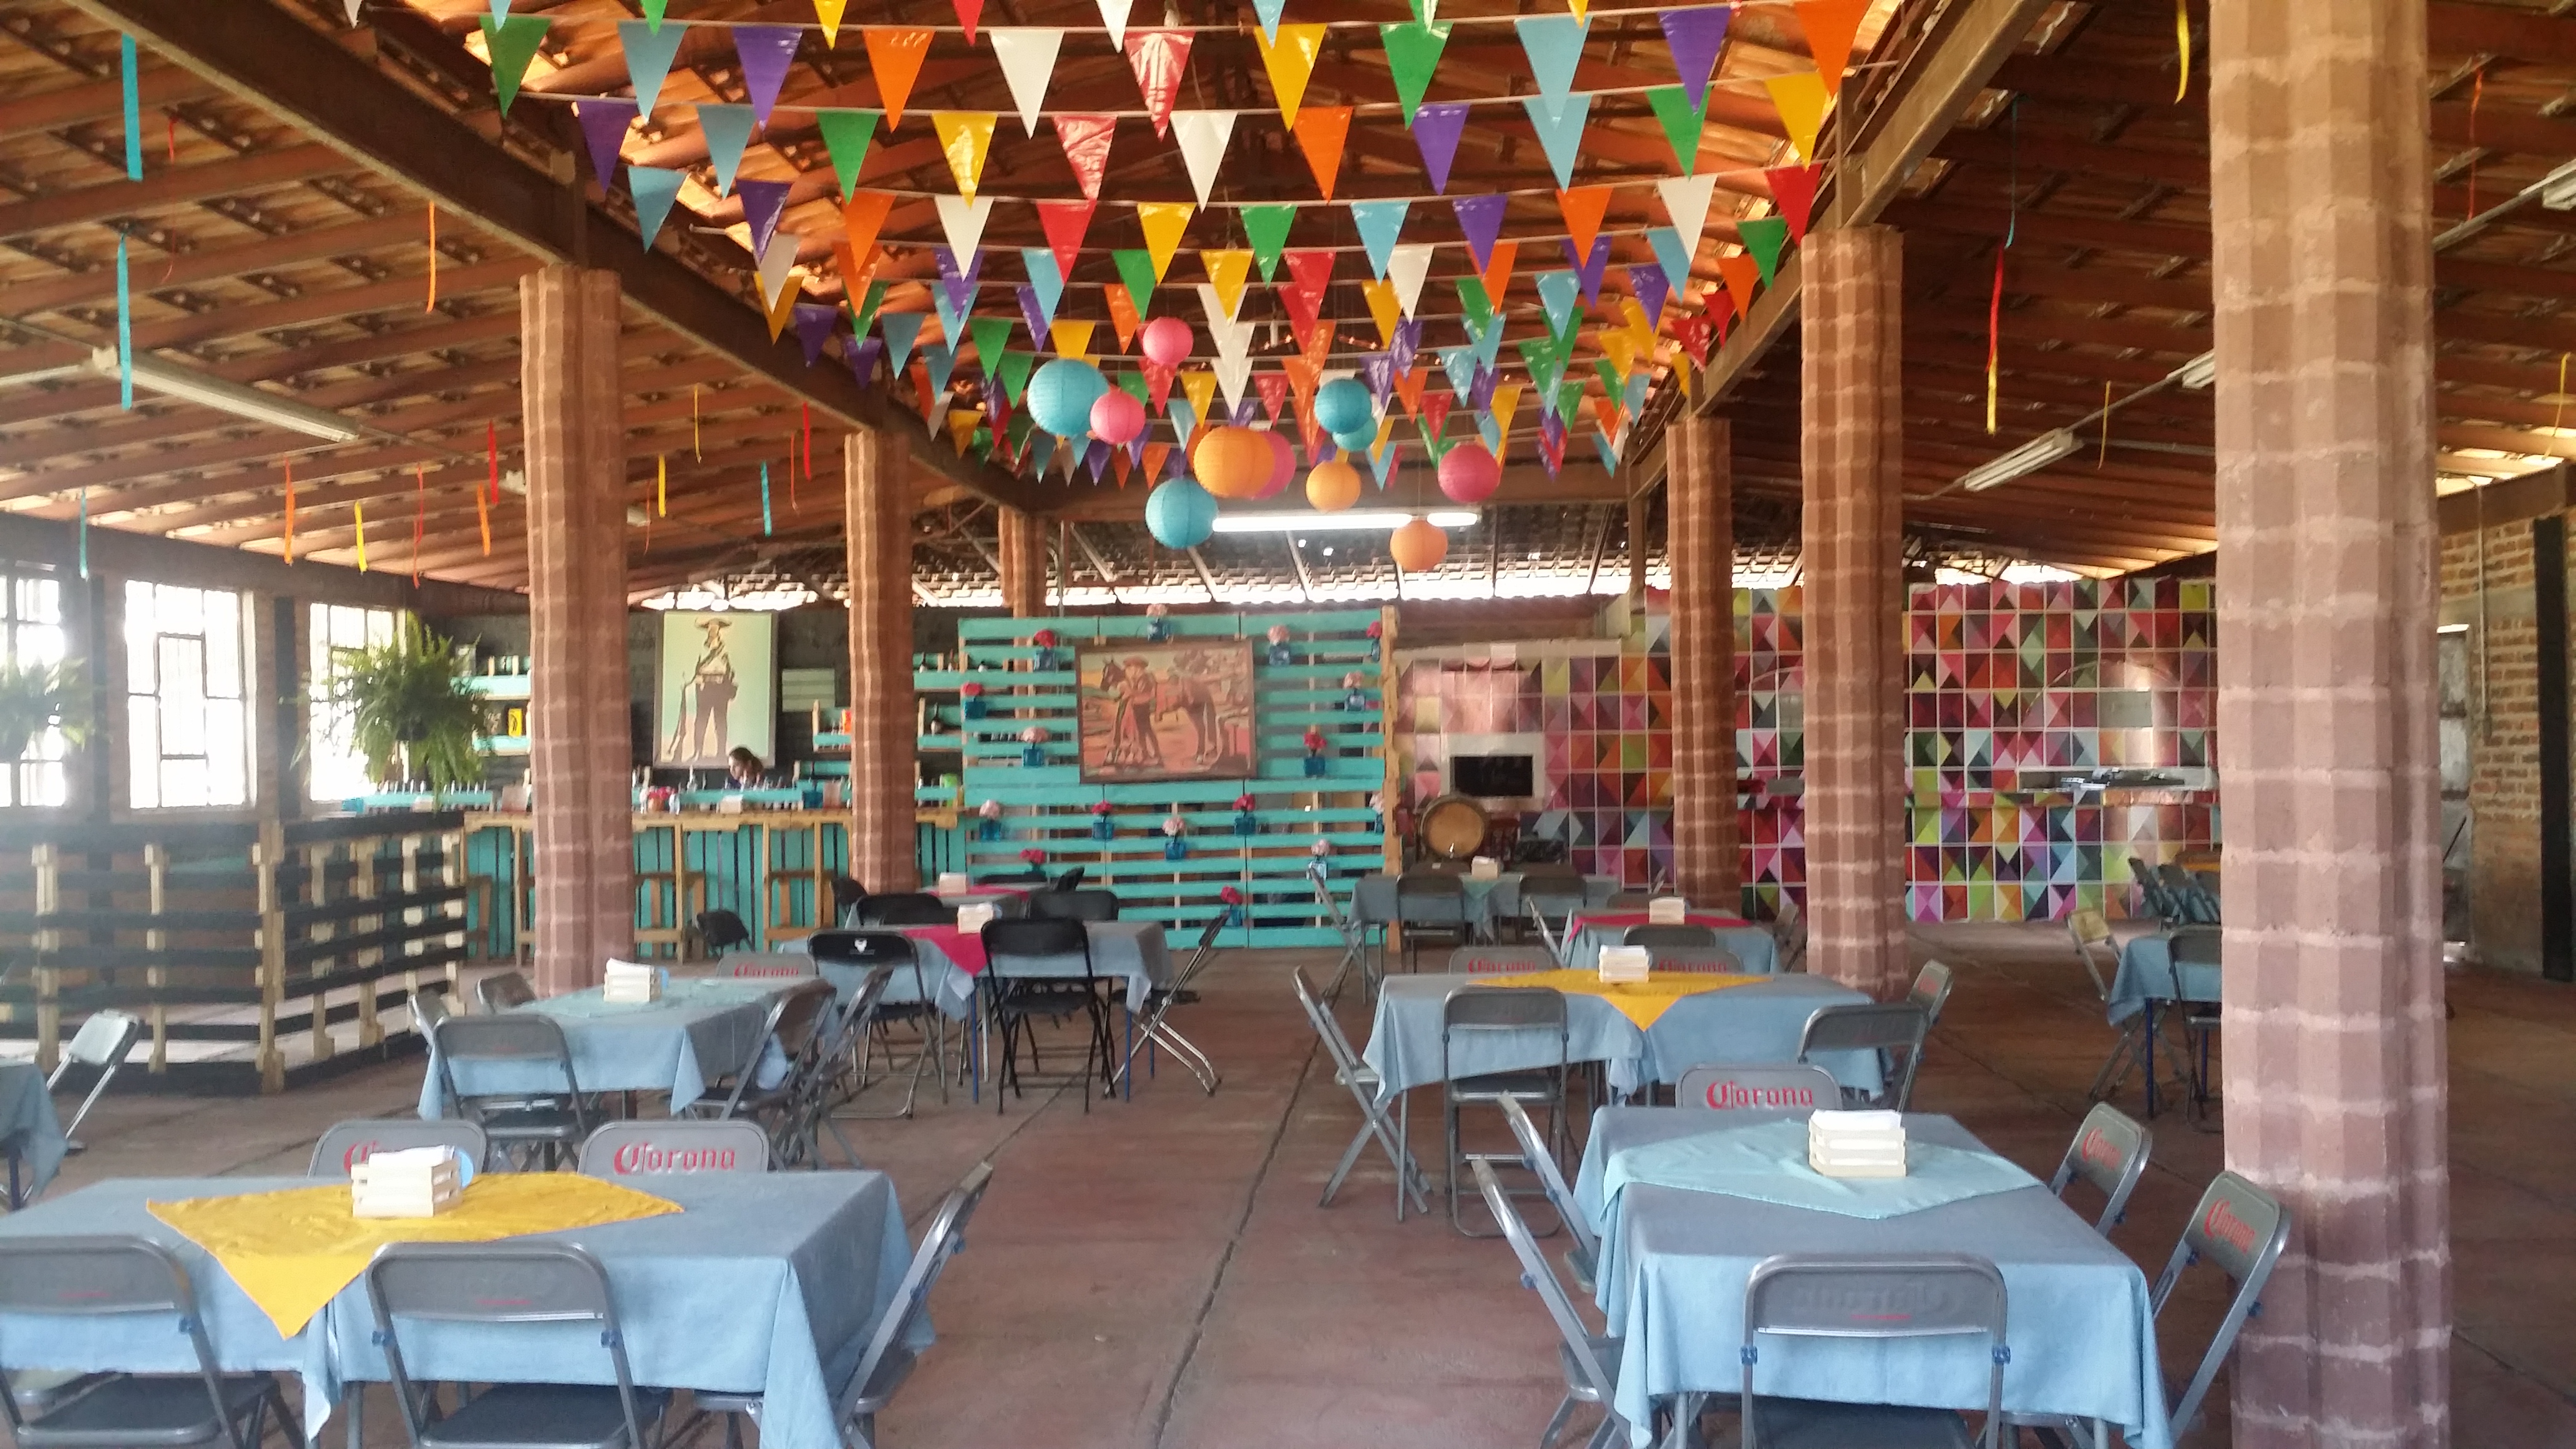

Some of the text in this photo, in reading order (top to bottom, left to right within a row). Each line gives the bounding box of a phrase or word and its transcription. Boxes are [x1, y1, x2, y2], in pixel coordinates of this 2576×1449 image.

[1707, 1080, 1813, 1110] Corona
[613, 1142, 735, 1176] Corona
[2204, 1196, 2255, 1254] Corona
